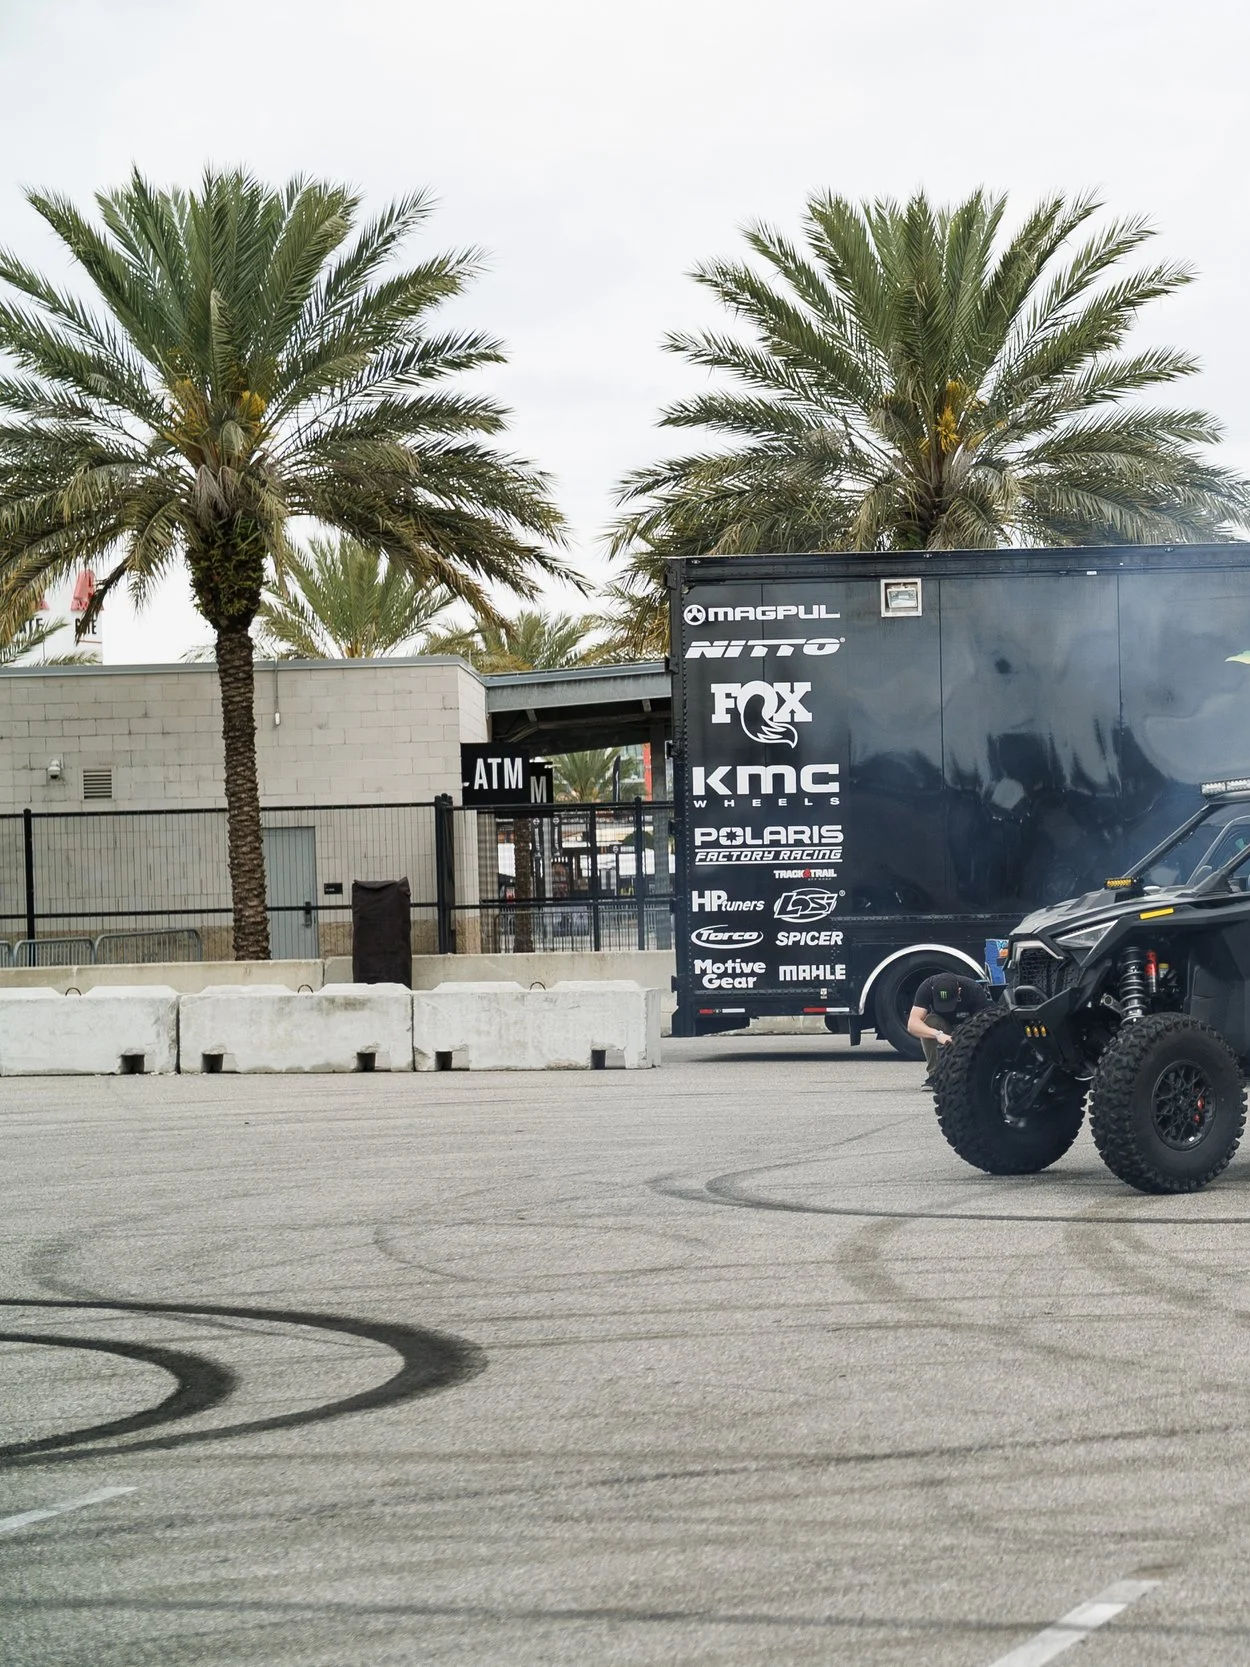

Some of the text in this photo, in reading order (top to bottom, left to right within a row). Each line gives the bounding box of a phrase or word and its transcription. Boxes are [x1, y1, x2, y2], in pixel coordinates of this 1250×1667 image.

[708, 604, 841, 622] MAGPUL
[684, 638, 841, 659] NITTO
[710, 680, 813, 749] FOX
[473, 757, 523, 790] ATM
[692, 764, 841, 796] KMC
[693, 797, 841, 808] WHEELS
[694, 825, 844, 846] POLARIS
[695, 849, 843, 863] FACTORY RACING
[775, 931, 844, 946] SPICER
[694, 958, 847, 981] Motive MAHLE
[702, 974, 758, 989] Gear
